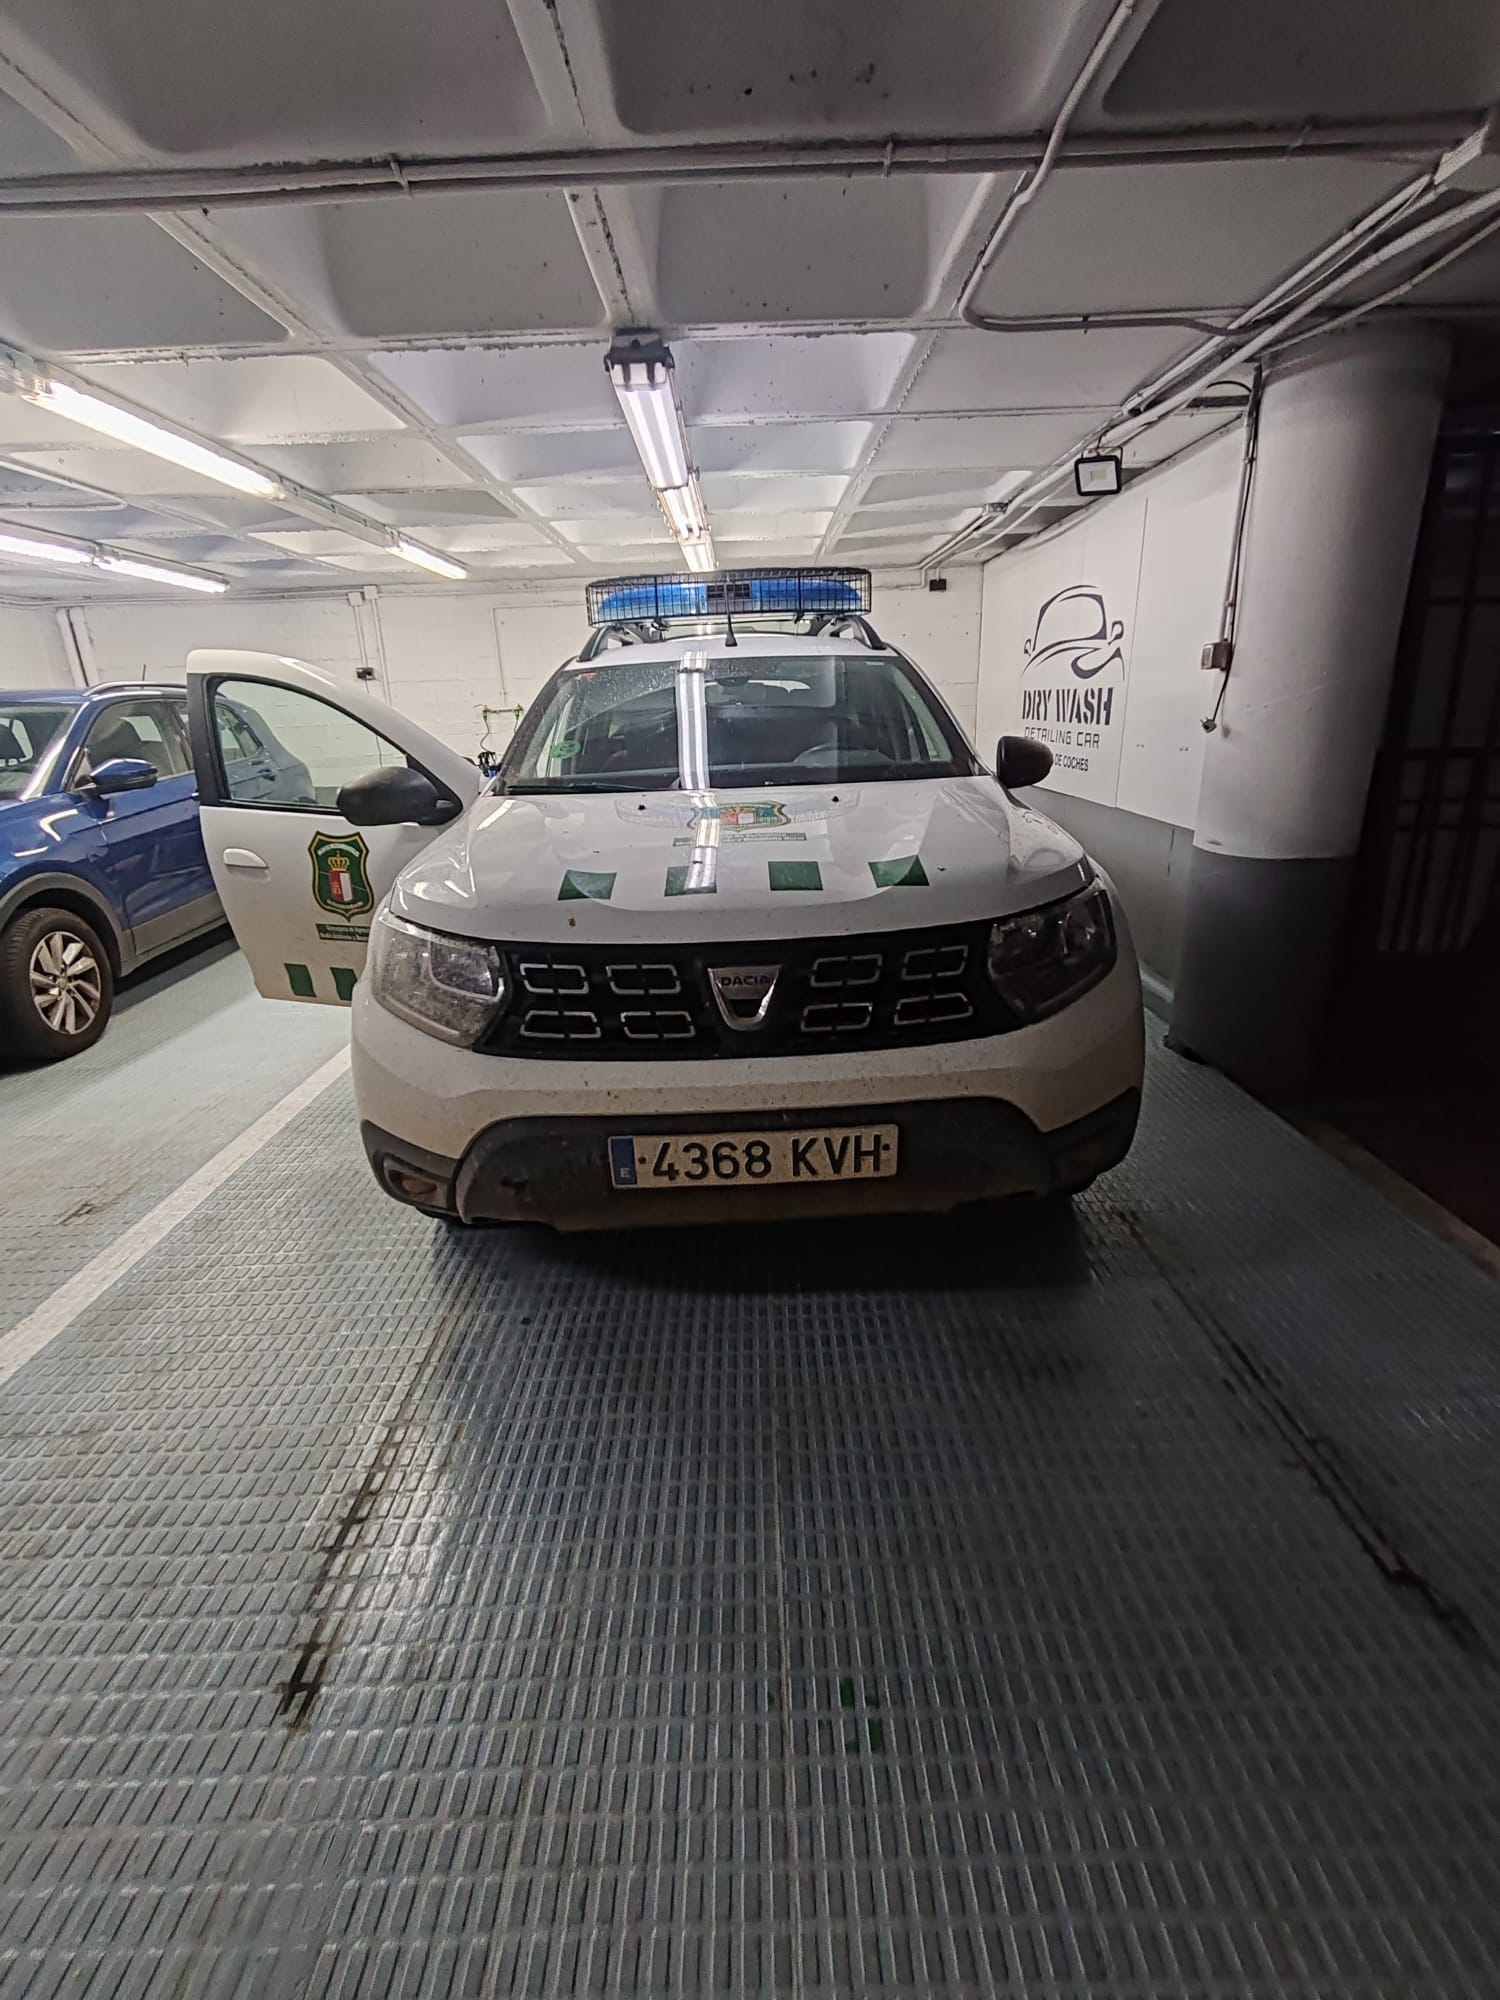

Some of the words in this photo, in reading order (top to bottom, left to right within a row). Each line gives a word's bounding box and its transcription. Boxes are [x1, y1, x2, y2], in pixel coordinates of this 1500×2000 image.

[1022, 690, 1051, 721] DRY
[1056, 687, 1113, 725] WASH
[1024, 726, 1072, 744] DETAILING
[1076, 731, 1100, 749] CAR
[1054, 753, 1062, 767] DE
[1062, 755, 1089, 772] COCHES
[720, 975, 770, 987] DACIA
[652, 1140, 772, 1181] 4368
[791, 1134, 882, 1177] KVH
[620, 1167, 630, 1178] E
